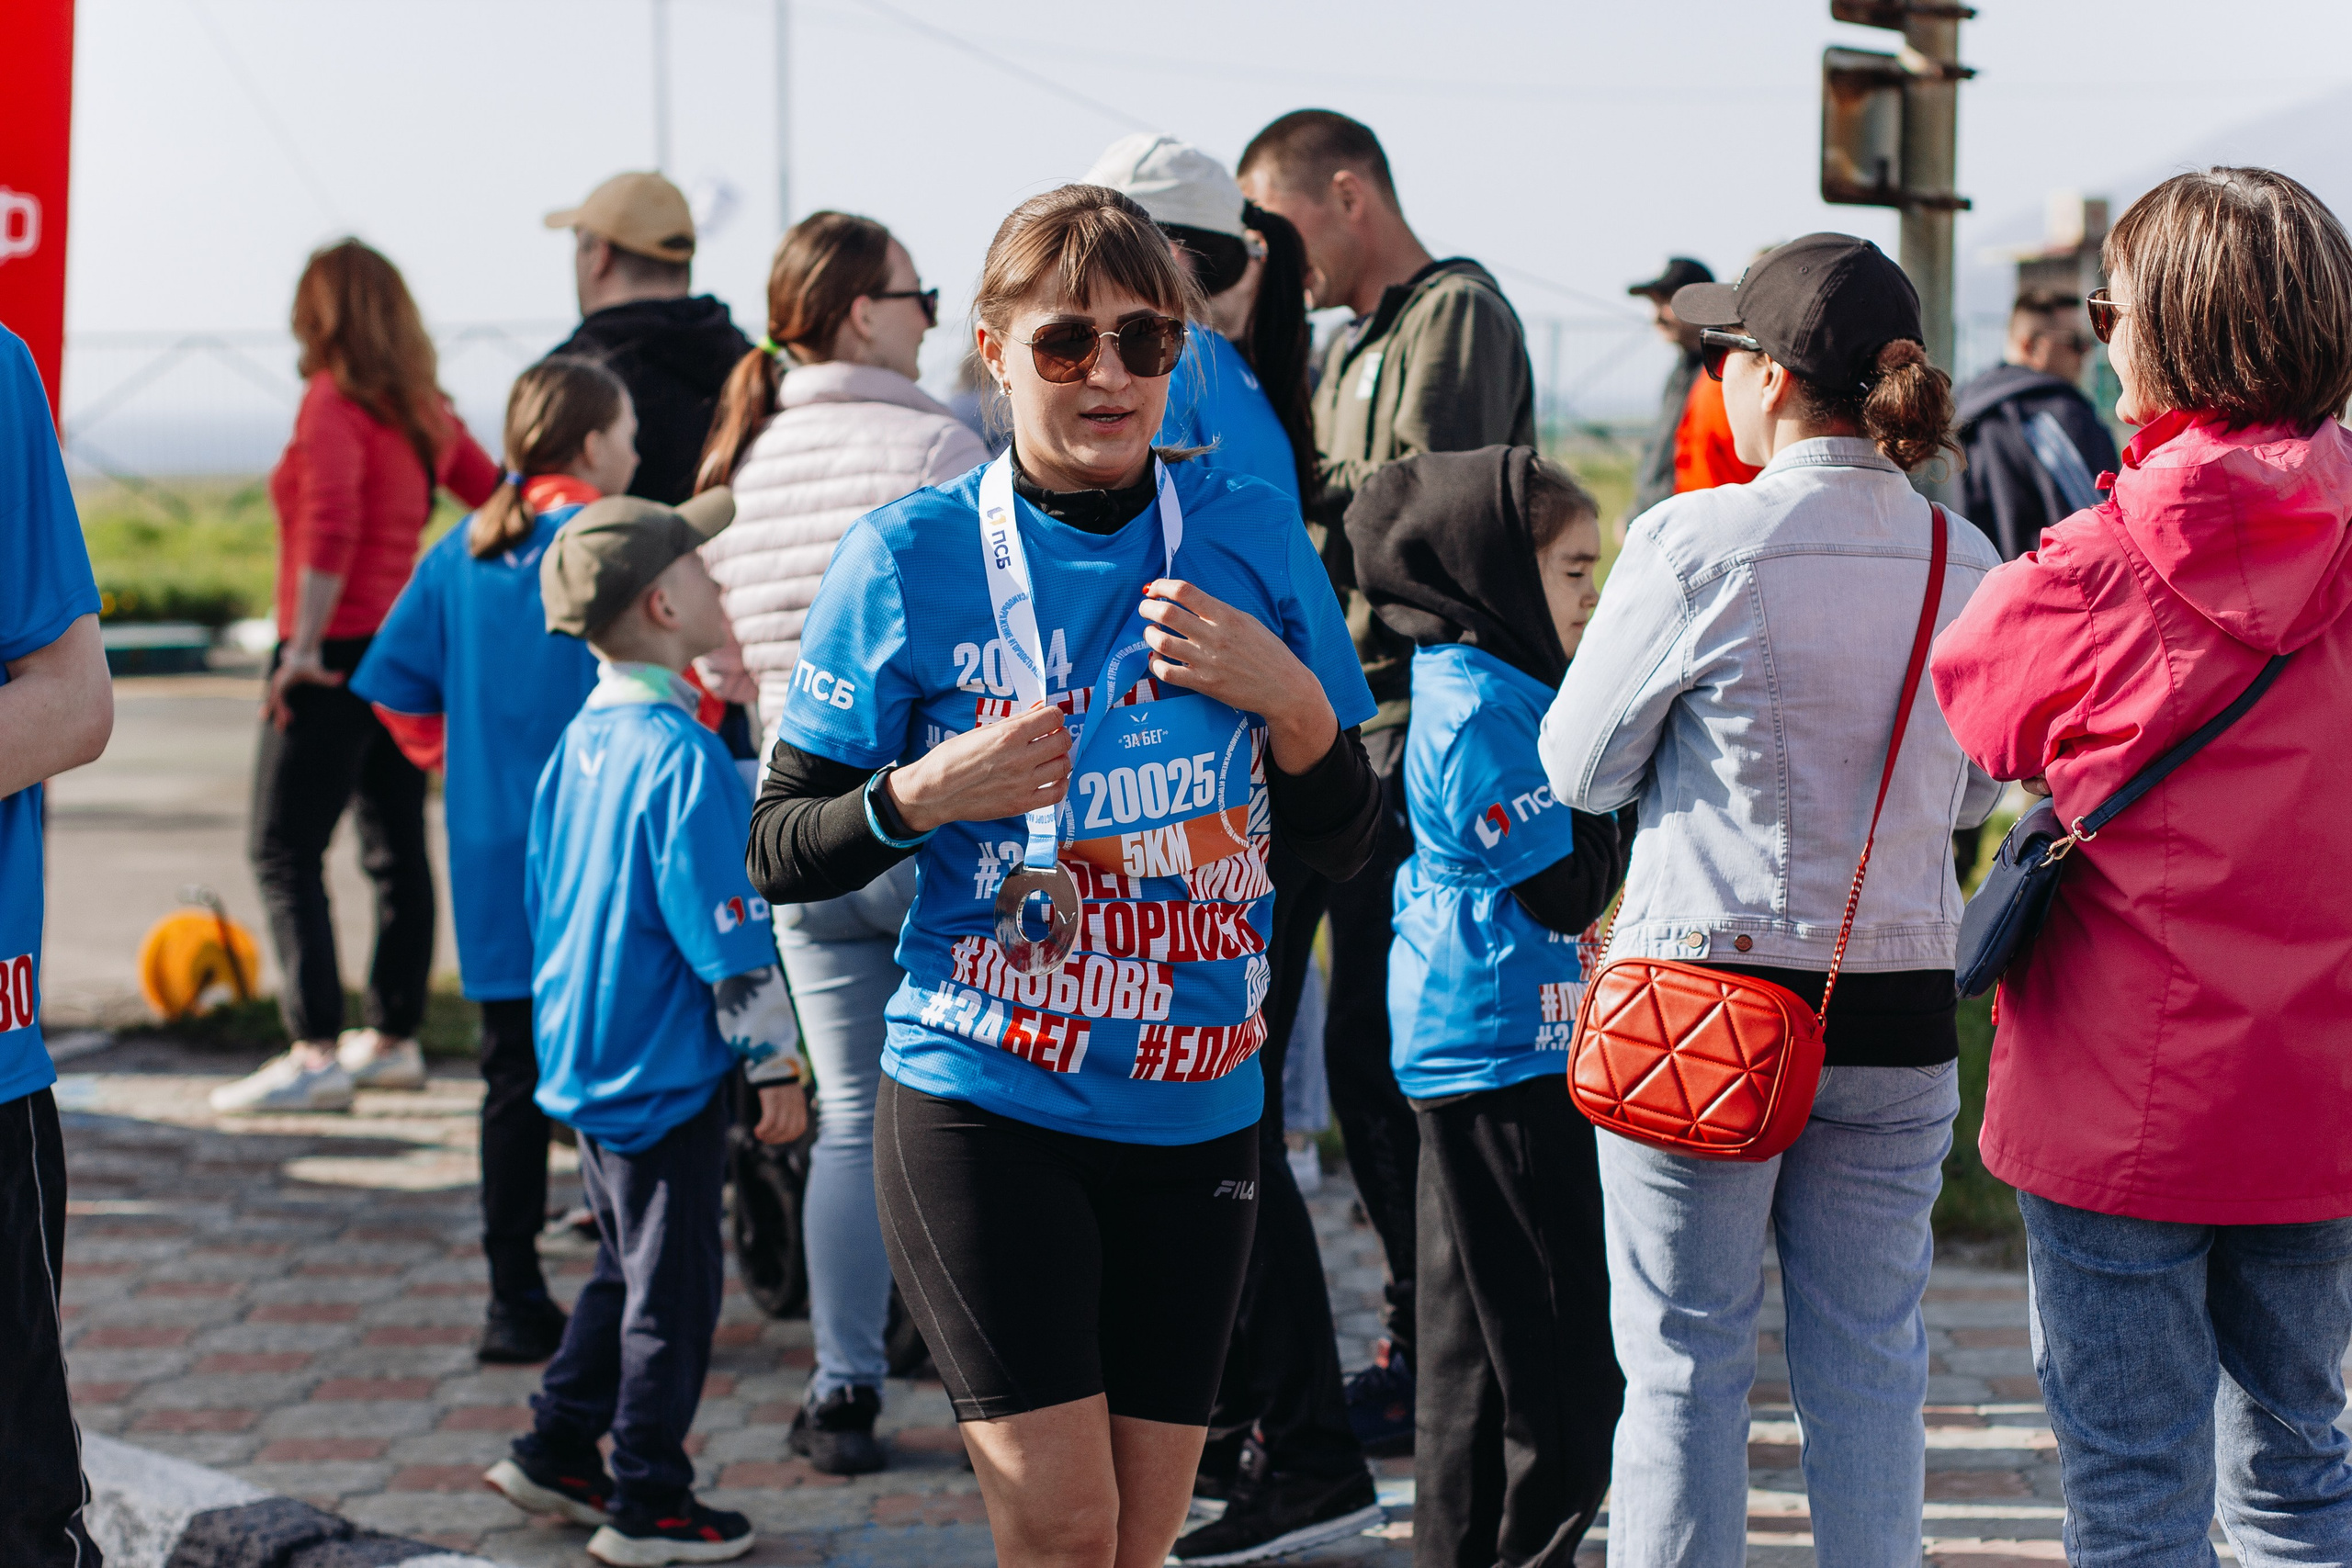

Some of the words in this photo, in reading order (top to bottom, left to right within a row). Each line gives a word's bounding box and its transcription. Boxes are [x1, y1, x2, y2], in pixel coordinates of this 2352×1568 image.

[991, 529, 1012, 570] ПСБ
[795, 659, 855, 710] ПСБ
[953, 628, 1072, 697] 204
[1079, 751, 1216, 829] 20025
[1121, 821, 1193, 878] 5КМ
[1050, 901, 1266, 962] ГОРДОСТЬ
[952, 935, 1173, 1021] #ЛЮБОВЬ
[921, 980, 1091, 1073] #ЗАБЕГ
[1213, 1180, 1255, 1200] FILA
